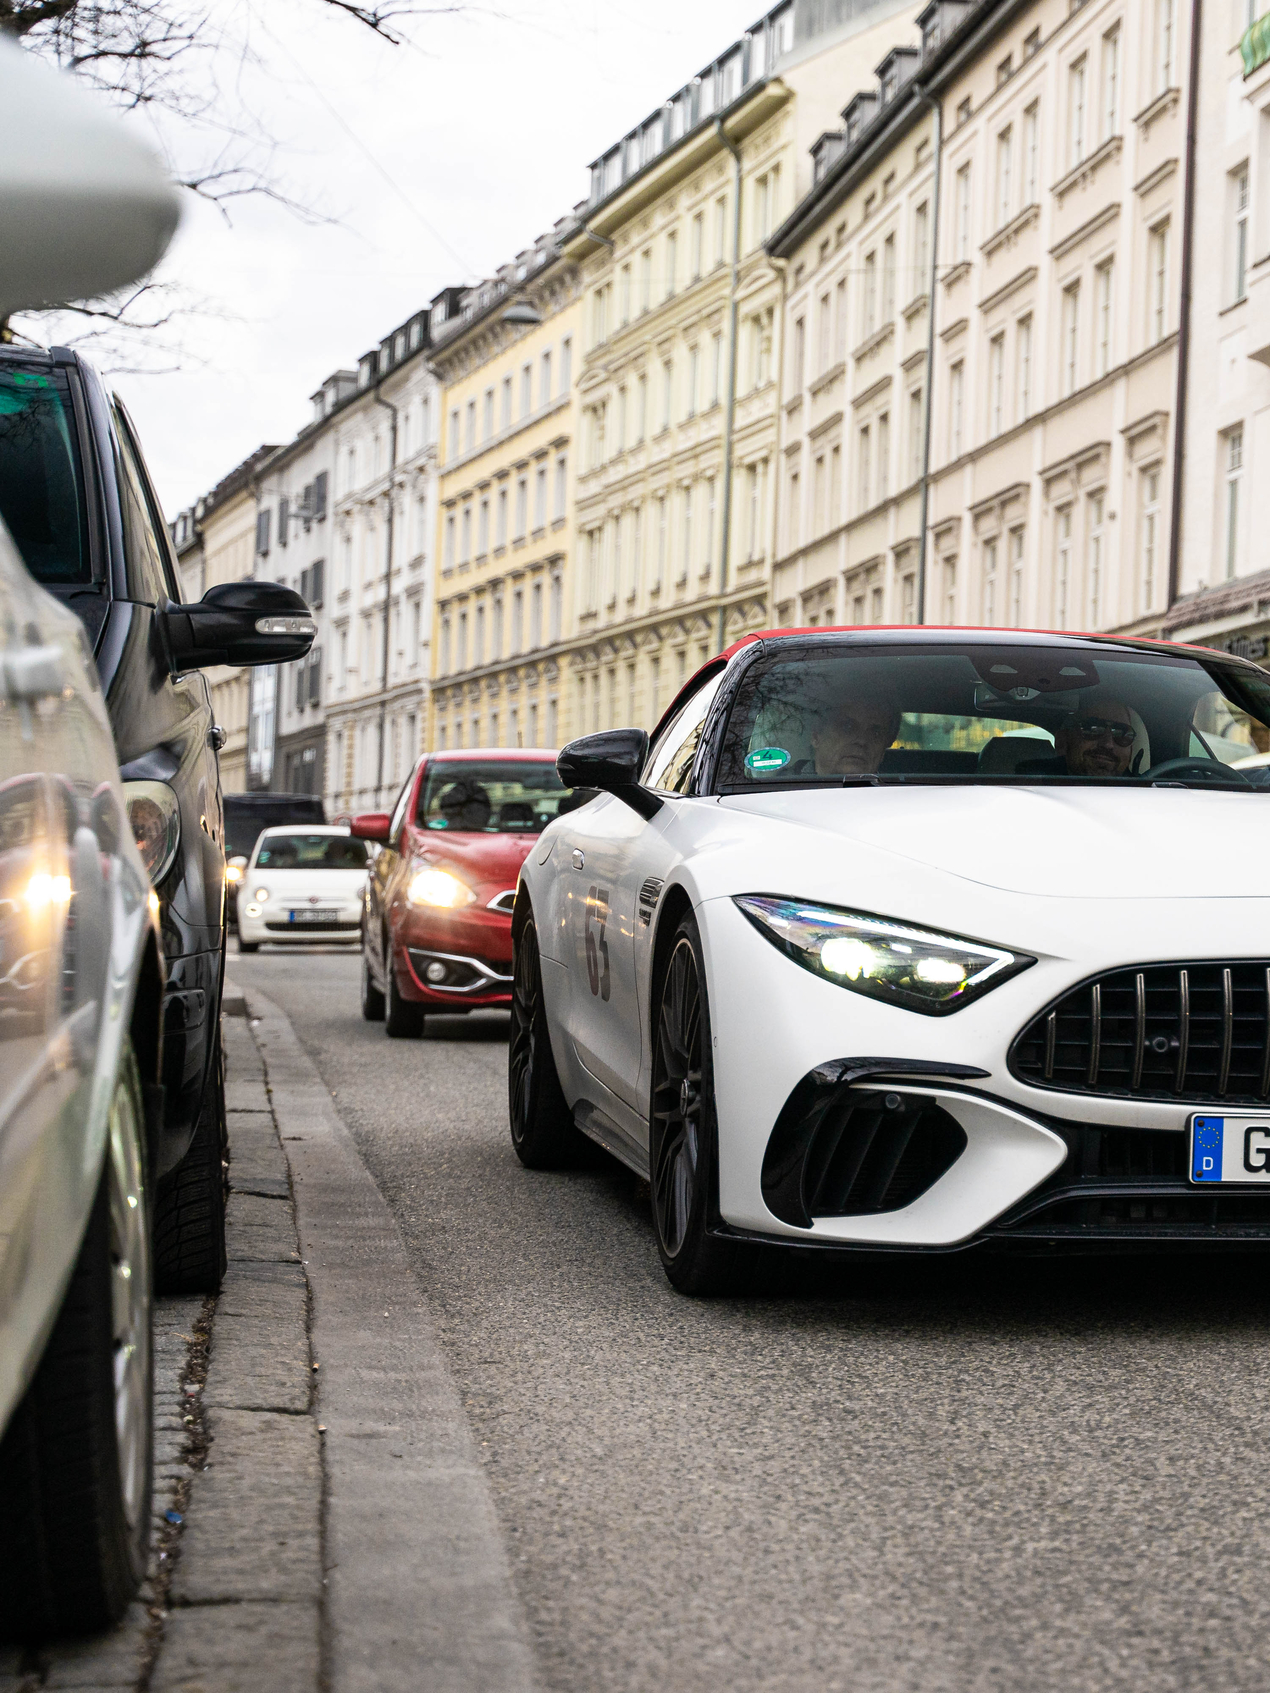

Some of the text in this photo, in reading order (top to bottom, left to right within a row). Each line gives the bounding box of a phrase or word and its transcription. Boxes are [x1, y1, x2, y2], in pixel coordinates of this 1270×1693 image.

[762, 750, 773, 760] 4
[585, 885, 611, 1002] 63
[1202, 1156, 1214, 1171] D
